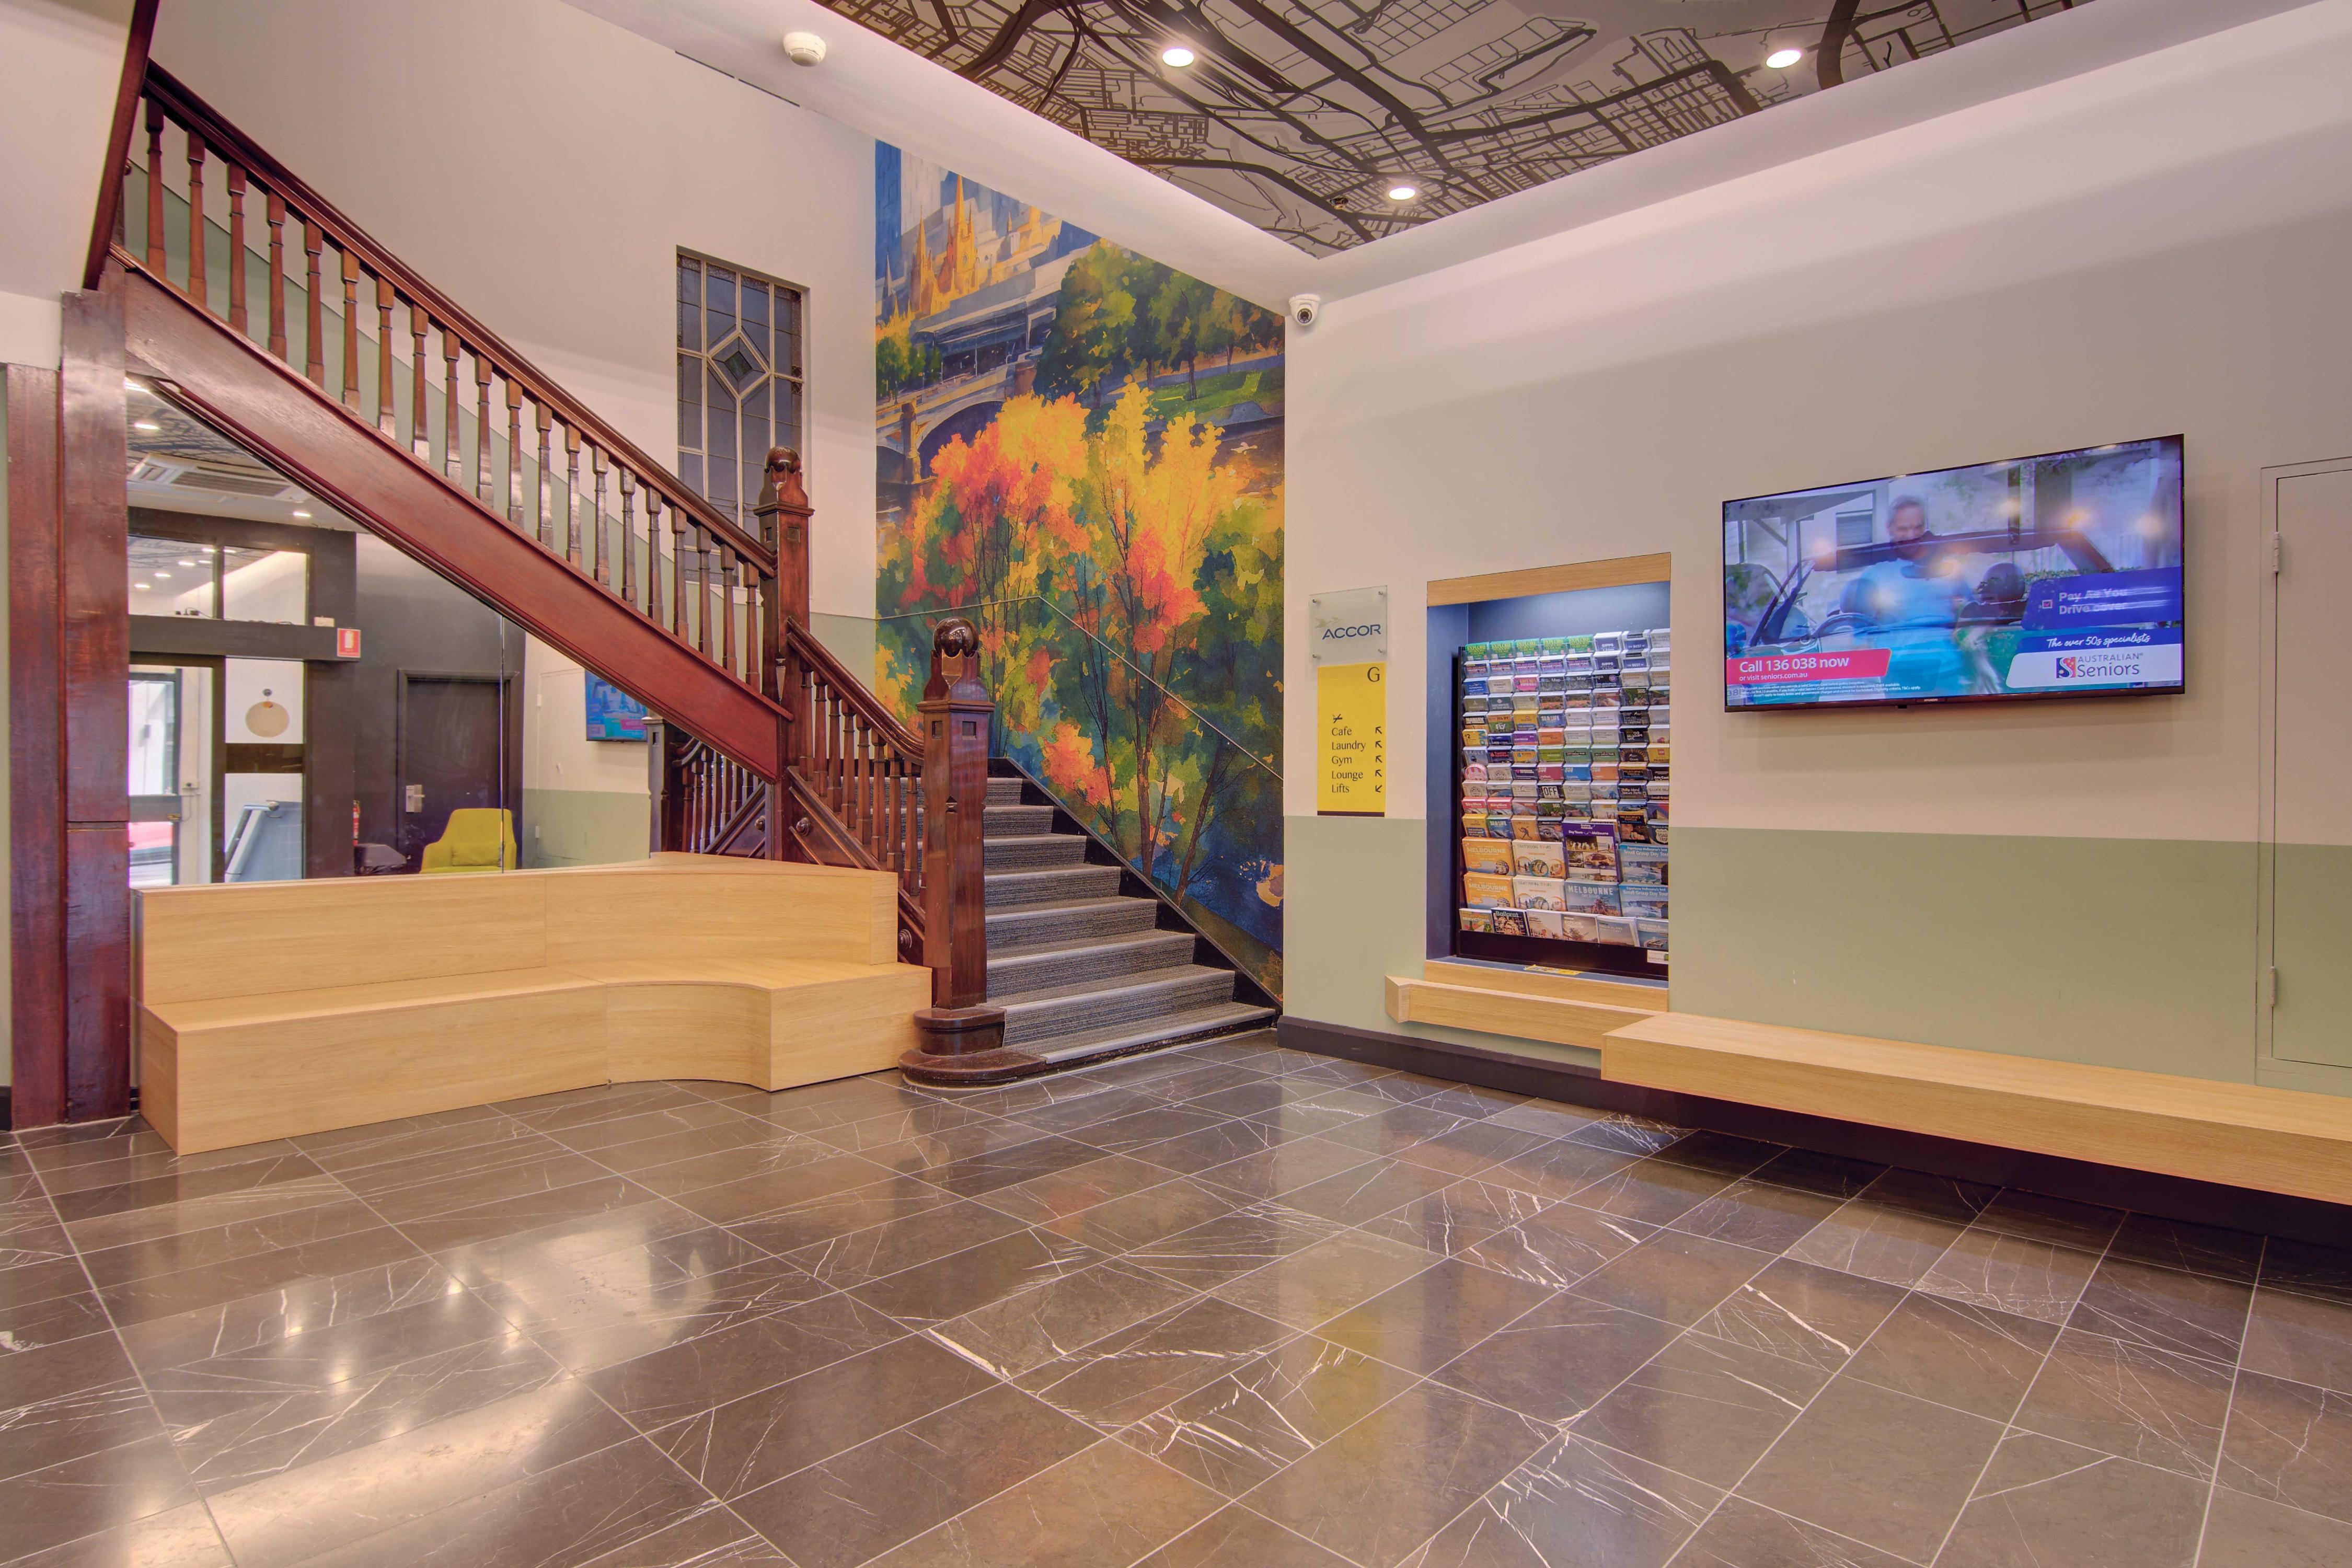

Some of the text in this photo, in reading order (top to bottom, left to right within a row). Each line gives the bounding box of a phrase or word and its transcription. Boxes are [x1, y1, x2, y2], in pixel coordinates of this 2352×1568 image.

[2059, 592, 2081, 602] Pay
[2059, 605, 2090, 614] Drive
[1322, 624, 1381, 640] ACCOR
[2046, 639, 2062, 648] The
[2086, 636, 2102, 645] 50s
[2102, 633, 2151, 648] specialists
[1739, 658, 1849, 673] Call 136 038 now
[2077, 663, 2139, 677] Seniors
[1367, 667, 1380, 682] G
[1332, 727, 1352, 736] Cafe
[1332, 740, 1366, 752] Laundry
[1332, 756, 1352, 766] Gym
[1332, 771, 1364, 781] Lounge
[1332, 783, 1350, 793] Lifts
[1543, 787, 1557, 795] OFF
[1568, 885, 1613, 895] MELBOURNE
